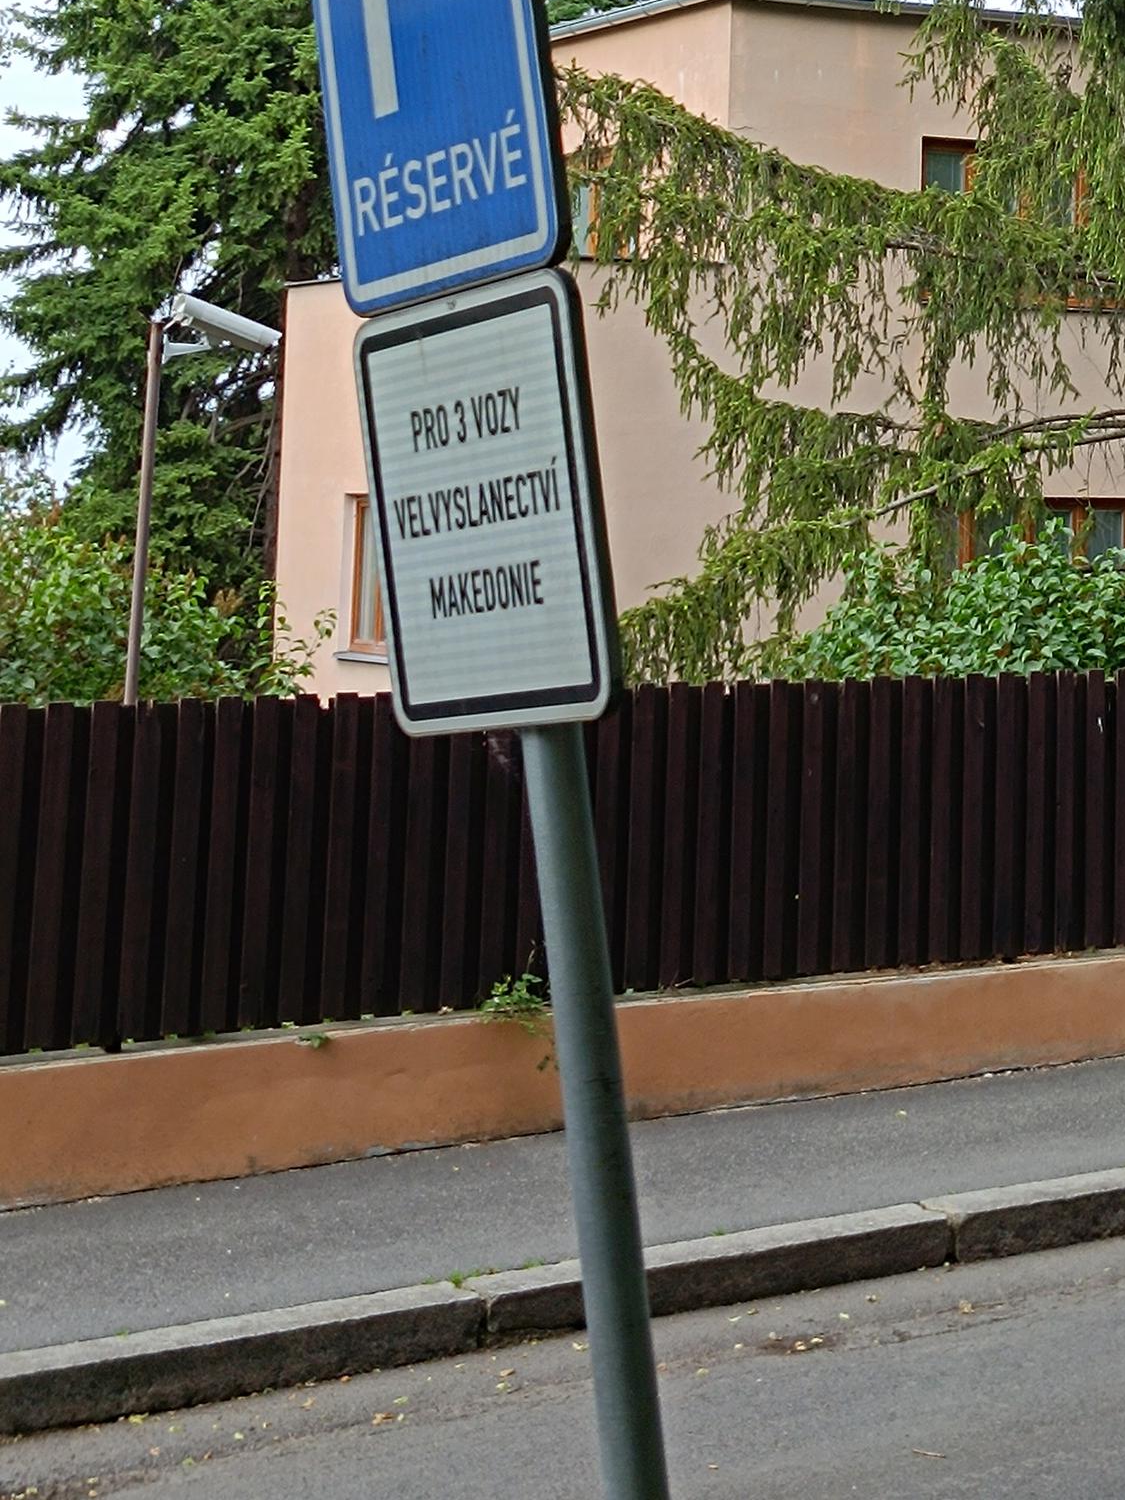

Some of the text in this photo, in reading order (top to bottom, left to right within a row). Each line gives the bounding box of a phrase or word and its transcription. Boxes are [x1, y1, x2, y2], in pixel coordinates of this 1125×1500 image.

[353, 110, 528, 236] RÉSERVÉ
[410, 386, 521, 452] PRO 3 VOZY
[393, 456, 561, 539] VELVYSLANECTVÍ
[429, 559, 545, 619] MAKEDONIE
